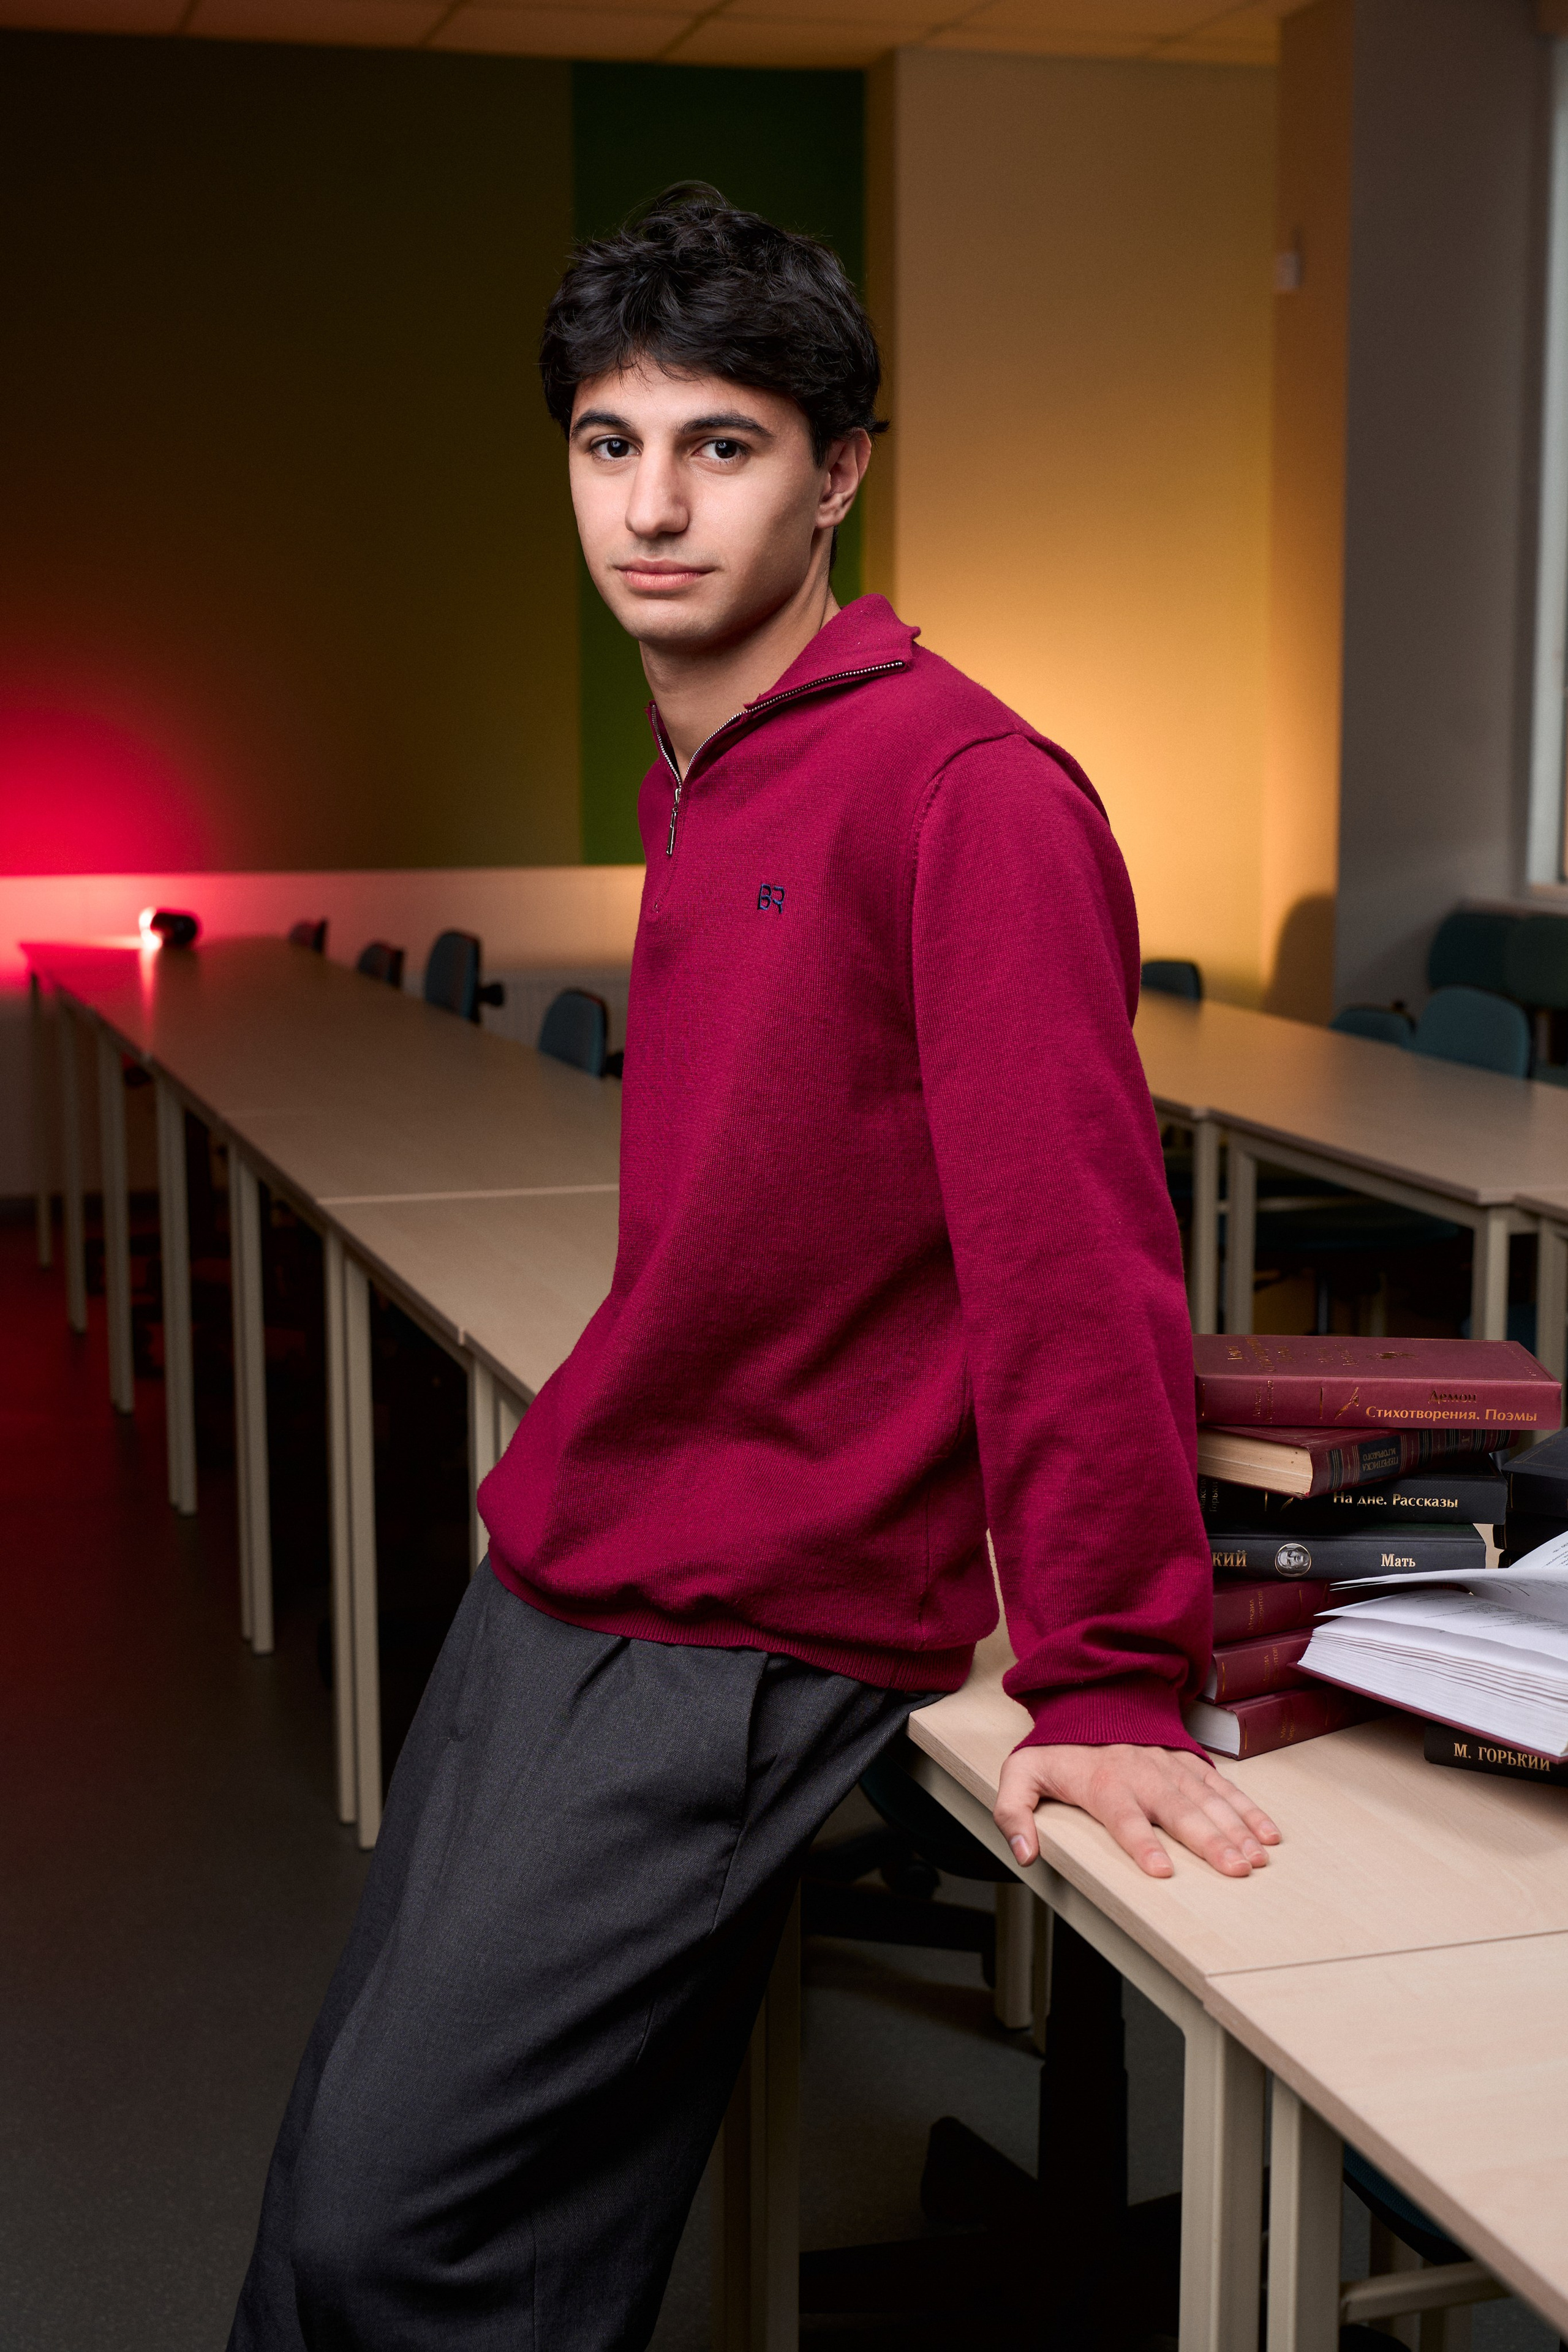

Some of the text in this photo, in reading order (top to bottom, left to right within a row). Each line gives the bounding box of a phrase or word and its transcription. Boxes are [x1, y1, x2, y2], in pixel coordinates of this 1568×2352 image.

[1428, 1390, 1477, 1404] Демон
[1365, 1406, 1537, 1421] Стихотворения. Поэмы
[1362, 1456, 1398, 1472] ПЕРЕПИСКА
[1333, 1491, 1458, 1508] На дне. Рассказы
[1381, 1553, 1416, 1567] Мать
[1453, 1743, 1471, 1758] М.
